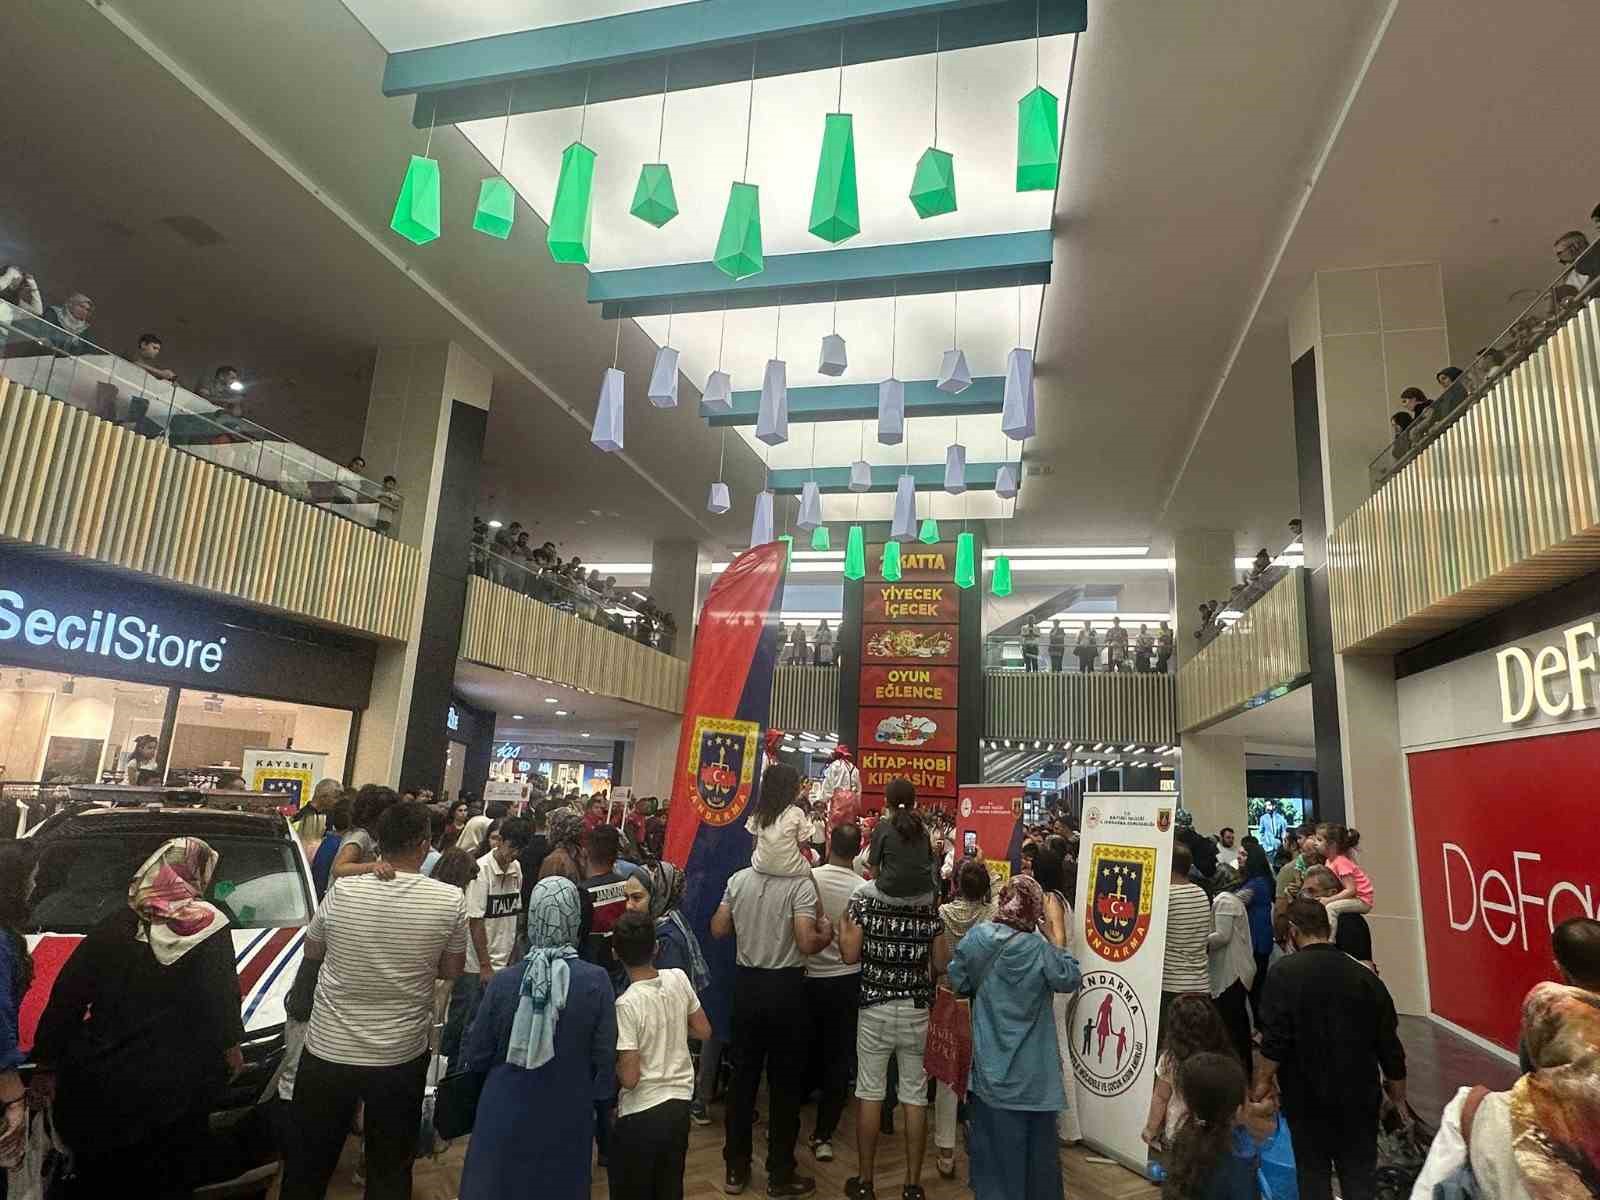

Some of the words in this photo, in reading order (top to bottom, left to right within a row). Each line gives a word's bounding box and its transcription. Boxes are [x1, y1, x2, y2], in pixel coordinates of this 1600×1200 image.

[880, 586, 943, 601] YİYECEK
[885, 602, 938, 618] İÇECEK
[888, 670, 930, 682] OYUN
[1496, 621, 1600, 723] DeF
[875, 684, 943, 700] EĞLENCE
[863, 753, 951, 772] KİTAP-HOBİ
[1442, 842, 1600, 951] DeFa
[1080, 975, 1139, 1015] ANDARMA
